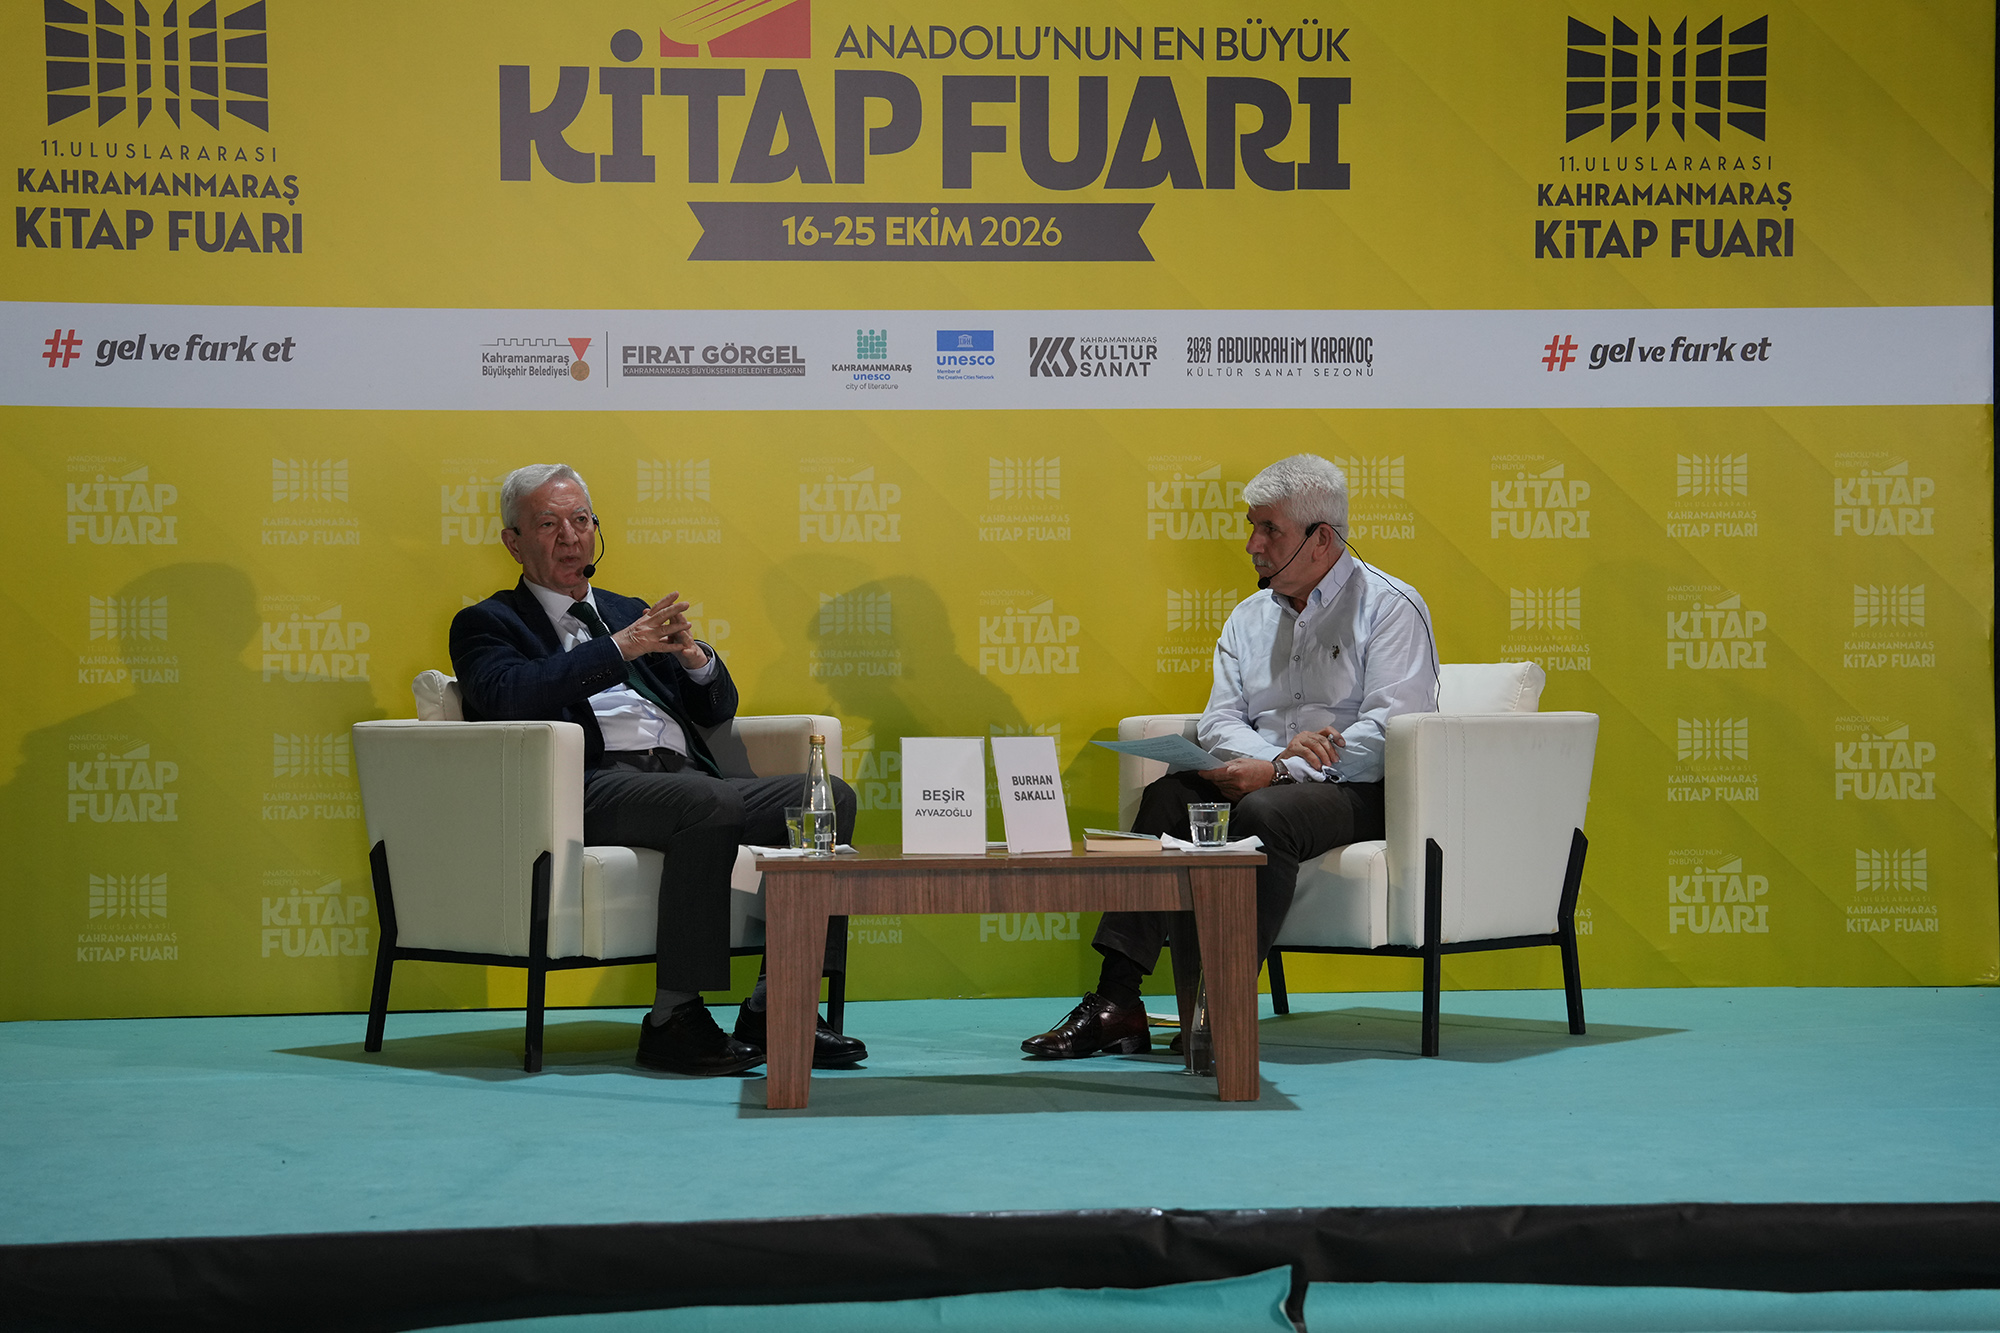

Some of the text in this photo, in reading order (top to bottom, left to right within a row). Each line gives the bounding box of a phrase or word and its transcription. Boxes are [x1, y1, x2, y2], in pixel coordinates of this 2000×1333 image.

[834, 18, 1351, 62] ANADOLU'NUN EN BÜYÜK
[499, 28, 1351, 191] KİTAP FUARI
[41, 139, 277, 162] 11.ULUSLARARASI
[1559, 156, 1772, 172] 11.ULUSLARARASI
[17, 168, 299, 206] KAHRAMANMARAŞ
[1537, 181, 1792, 210] KAHRAMANMARAŞ
[168, 210, 302, 254] FUARI
[782, 207, 1062, 247] 16-25 EKİM 2026
[1671, 218, 1794, 258] FUARI
[1080, 336, 1157, 344] KAHRAMANMARAŞ
[1187, 337, 1212, 350] 2026
[95, 333, 147, 368] gel
[149, 343, 180, 361] ve
[184, 334, 256, 364] fark
[262, 336, 296, 363] et
[623, 342, 806, 365] FIRAT GÖRGEL
[1187, 350, 1212, 363] 2027
[1311, 337, 1374, 367] KARAKOÇ
[1588, 336, 1634, 370] gel
[1638, 344, 1665, 363] ve
[1668, 336, 1738, 364] fark
[1740, 339, 1772, 362] et
[482, 353, 570, 366] Kahramanmaraş
[936, 355, 995, 366] unesco
[482, 366, 570, 378] Büyükşehir Belediyesi
[624, 367, 690, 376] KAHRAMANMARAŞ
[831, 364, 912, 374] KAHRAMANMARAŞ
[853, 373, 891, 381] unesco
[1187, 367, 1373, 377] KÜLTÜR SANAT SEZONU
[845, 383, 858, 391] city
[67, 474, 178, 512] KİTAP
[441, 476, 501, 513] KİT
[800, 474, 901, 511] KİTAP
[1490, 472, 1590, 508] KİTAP
[1834, 470, 1935, 506] KİTAP
[262, 517, 359, 528] KAHRAMANMARAŞ
[626, 516, 720, 527] KAHRAMANMARAŞ
[980, 514, 1070, 524] KAHRAMANMARAŞ
[1667, 510, 1757, 521] KAHRAMANMARAŞ
[1834, 508, 1935, 536] FUARI
[67, 516, 178, 544] FUARI
[800, 514, 901, 542] FUARI
[1147, 512, 1247, 540] FUARI
[1490, 510, 1590, 539] FUARI
[1714, 523, 1758, 538] FUARI
[313, 530, 361, 545] FUARI
[676, 530, 722, 544] FUARI
[1027, 527, 1071, 541] FUARI
[1372, 526, 1415, 540] FUARI
[980, 607, 1080, 644] KİTAP
[1667, 602, 1767, 639] KİTAP
[262, 613, 370, 650] KİTAP
[810, 649, 900, 659] KAHRAMANMARAŞ
[1500, 644, 1590, 654] KAHRAMANMARAŞ
[1844, 641, 1934, 651] KAHRAMANMARAŞ
[79, 655, 178, 666] KAHRAMANMARAŞ
[980, 646, 1080, 675] FUARI
[1548, 657, 1592, 670] FUARI
[1667, 641, 1767, 670] FUARI
[1891, 654, 1936, 668] FUARI
[262, 654, 370, 682] FUARI
[858, 662, 902, 677] FUARI
[132, 670, 180, 684] FUARI
[1834, 732, 1936, 770] KİTAP
[68, 752, 178, 790] KİTAP
[1012, 775, 1053, 786] BURHAN
[1668, 774, 1758, 785] KAHRAMANMARAŞ
[1834, 772, 1936, 800] FUARI
[263, 792, 360, 802] KAHRAMANMARAŞ
[922, 787, 965, 803] BEŞİR
[1014, 790, 1055, 801] SAKALLI
[1715, 786, 1759, 801] FUARI
[68, 793, 178, 823] FUARI
[314, 805, 361, 820] FUARI
[915, 808, 972, 817] AYVAZOĞLU
[1668, 866, 1769, 904] KİTAP
[261, 888, 369, 926] KİTAP
[1846, 906, 1938, 916] KAHRAMANMARAŞ
[980, 912, 1080, 942] FUARI
[1668, 906, 1769, 934] FUARI
[1894, 918, 1939, 932] FUARI
[78, 932, 178, 944] KAHRAMANMARAŞ
[261, 928, 369, 958] FUARI
[130, 946, 178, 962] FUARI
